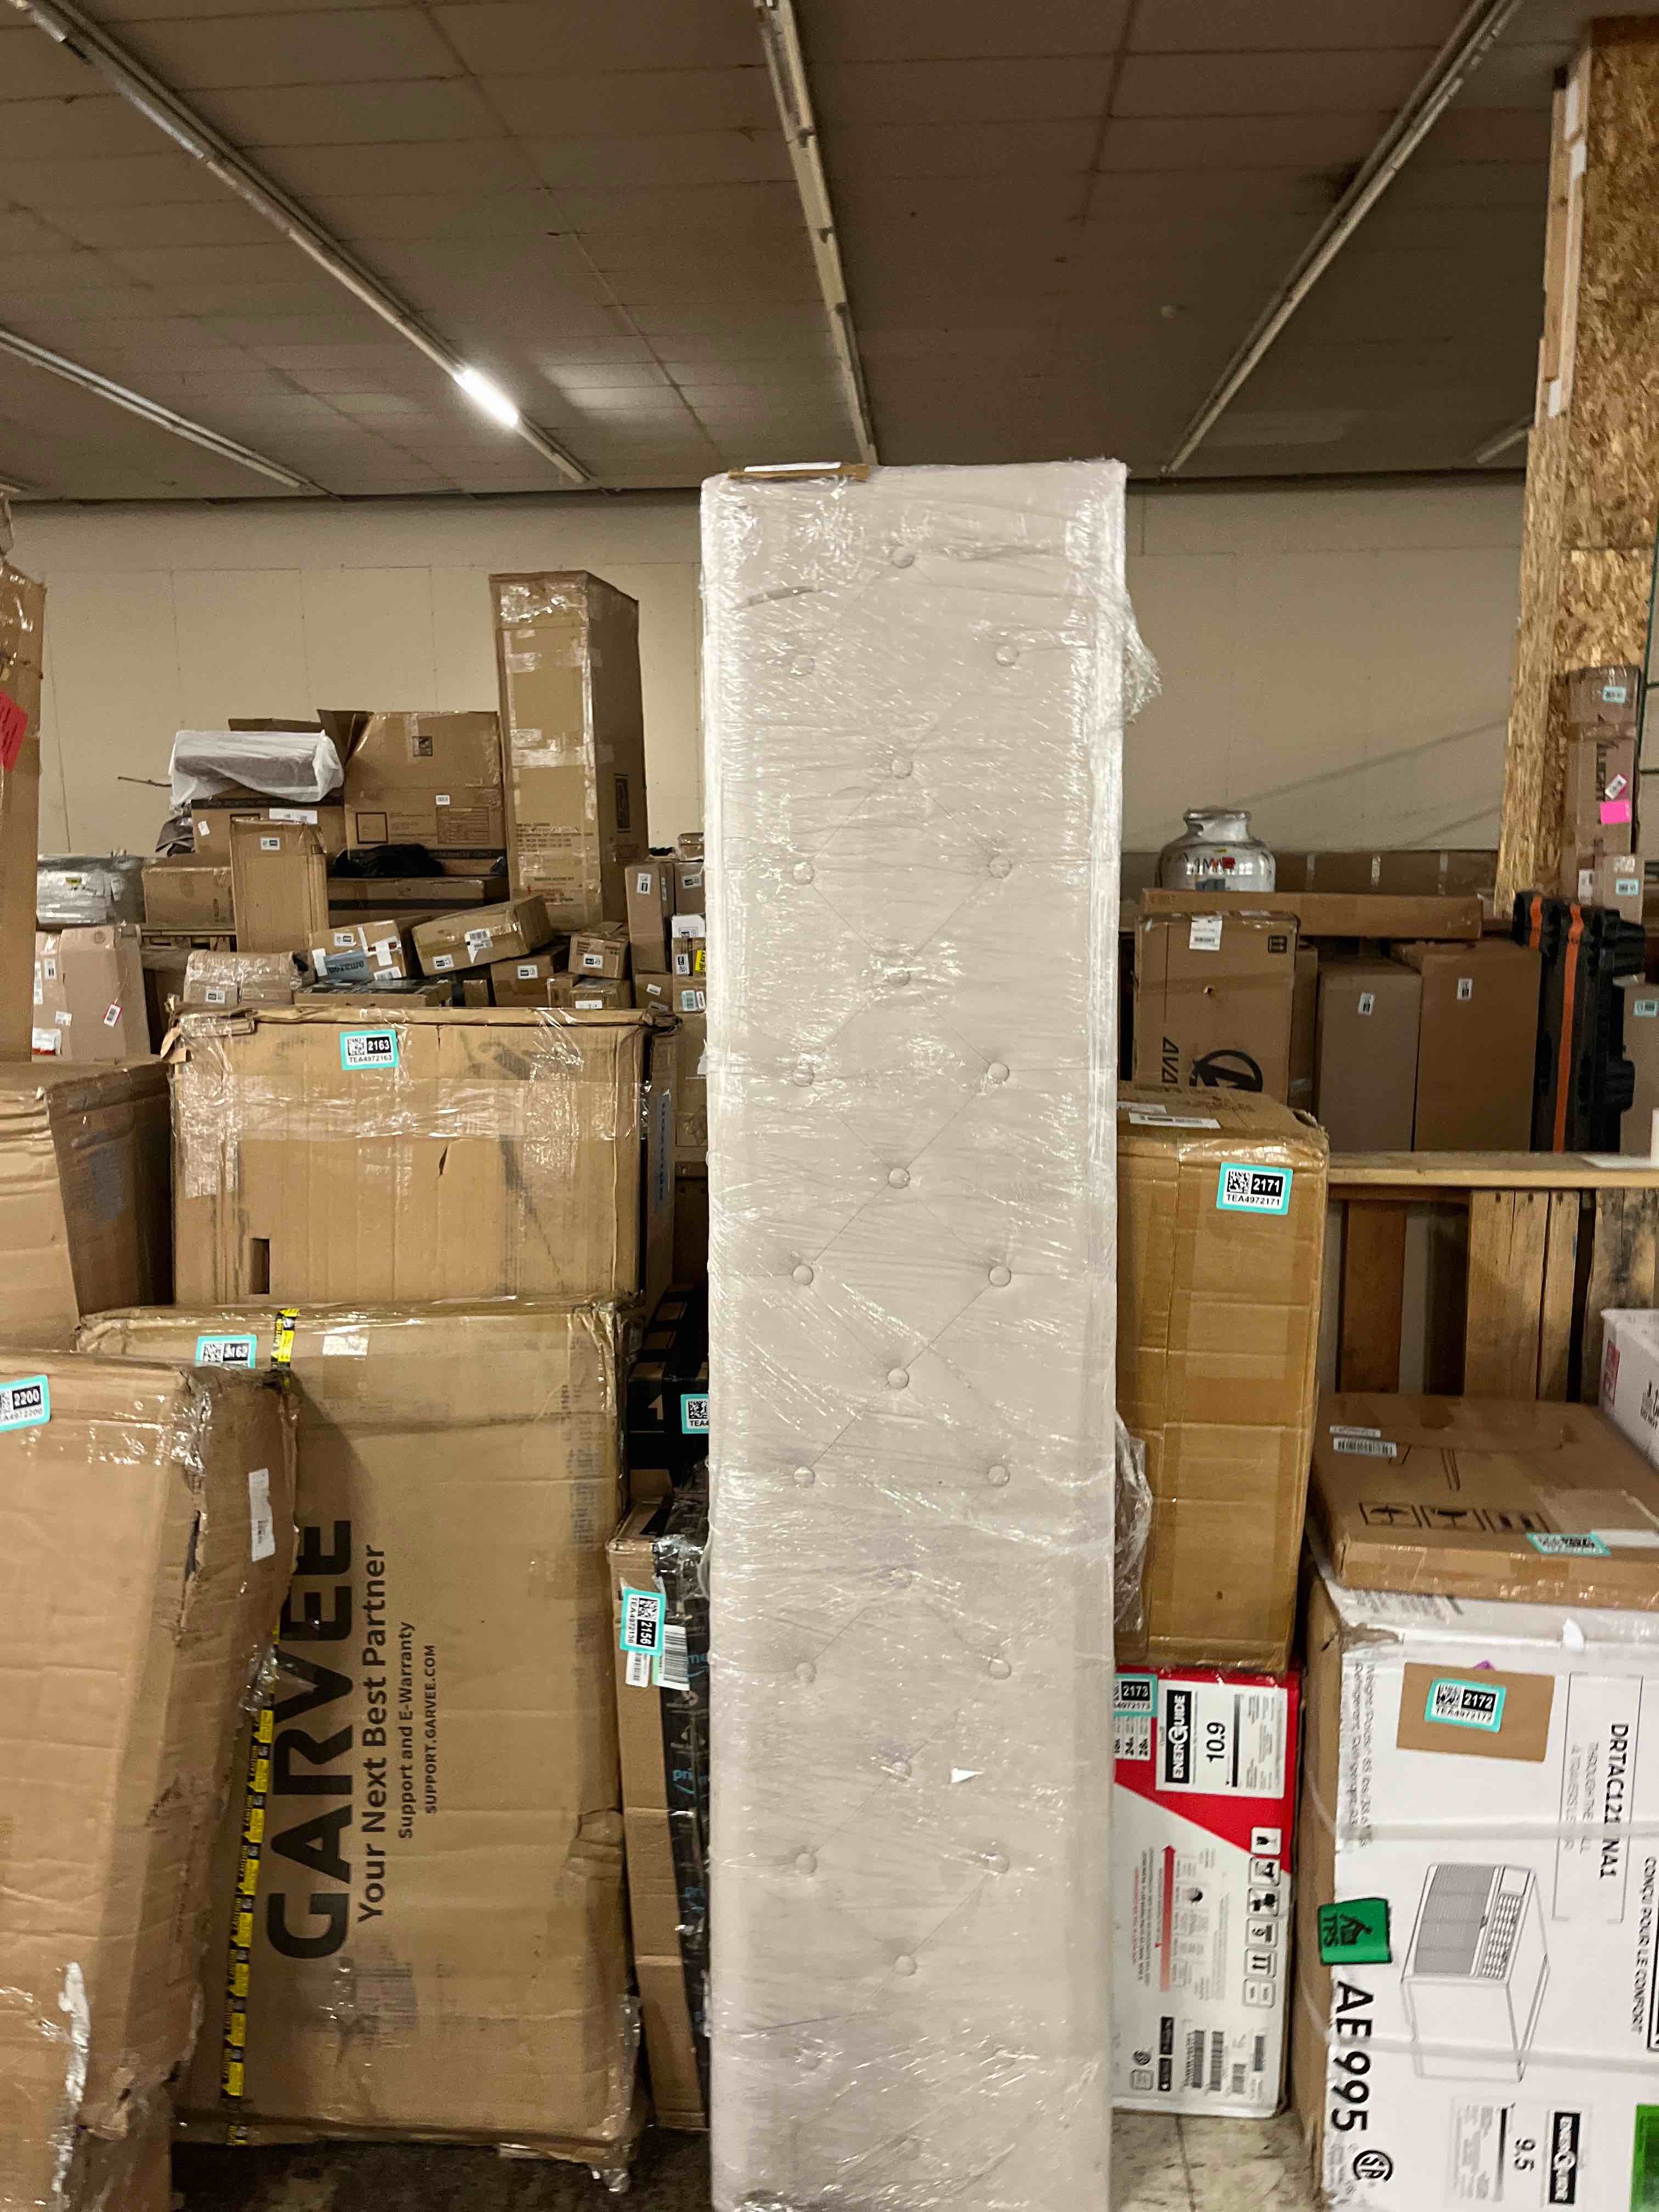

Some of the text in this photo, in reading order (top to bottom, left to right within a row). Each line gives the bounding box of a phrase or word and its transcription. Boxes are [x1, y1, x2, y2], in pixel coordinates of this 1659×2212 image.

[349, 1054, 392, 1063] TEA4972163
[368, 1039, 390, 1051] 2163
[1161, 1035, 1179, 1085] AVA
[1226, 1193, 1280, 1206] TEA4972171
[1253, 1177, 1280, 1193] 2171
[14, 1389, 40, 1406] 2200
[640, 1621, 652, 1645] 2156
[1123, 1685, 1149, 1697] 2173
[1464, 1692, 1493, 1709] 2172
[266, 1520, 353, 1959] GARVEE
[358, 1544, 387, 1922] Your Next Best Partner
[398, 1622, 416, 1839] Support and E-Warranty
[425, 1645, 437, 1814] SUPPORT.GARVEE.COM
[1168, 1694, 1189, 1779] ENERGUIDE
[1206, 1722, 1225, 1763] 10.9
[1331, 1980, 1374, 2132] AE995
[1514, 2138, 1535, 2171] 9.5
